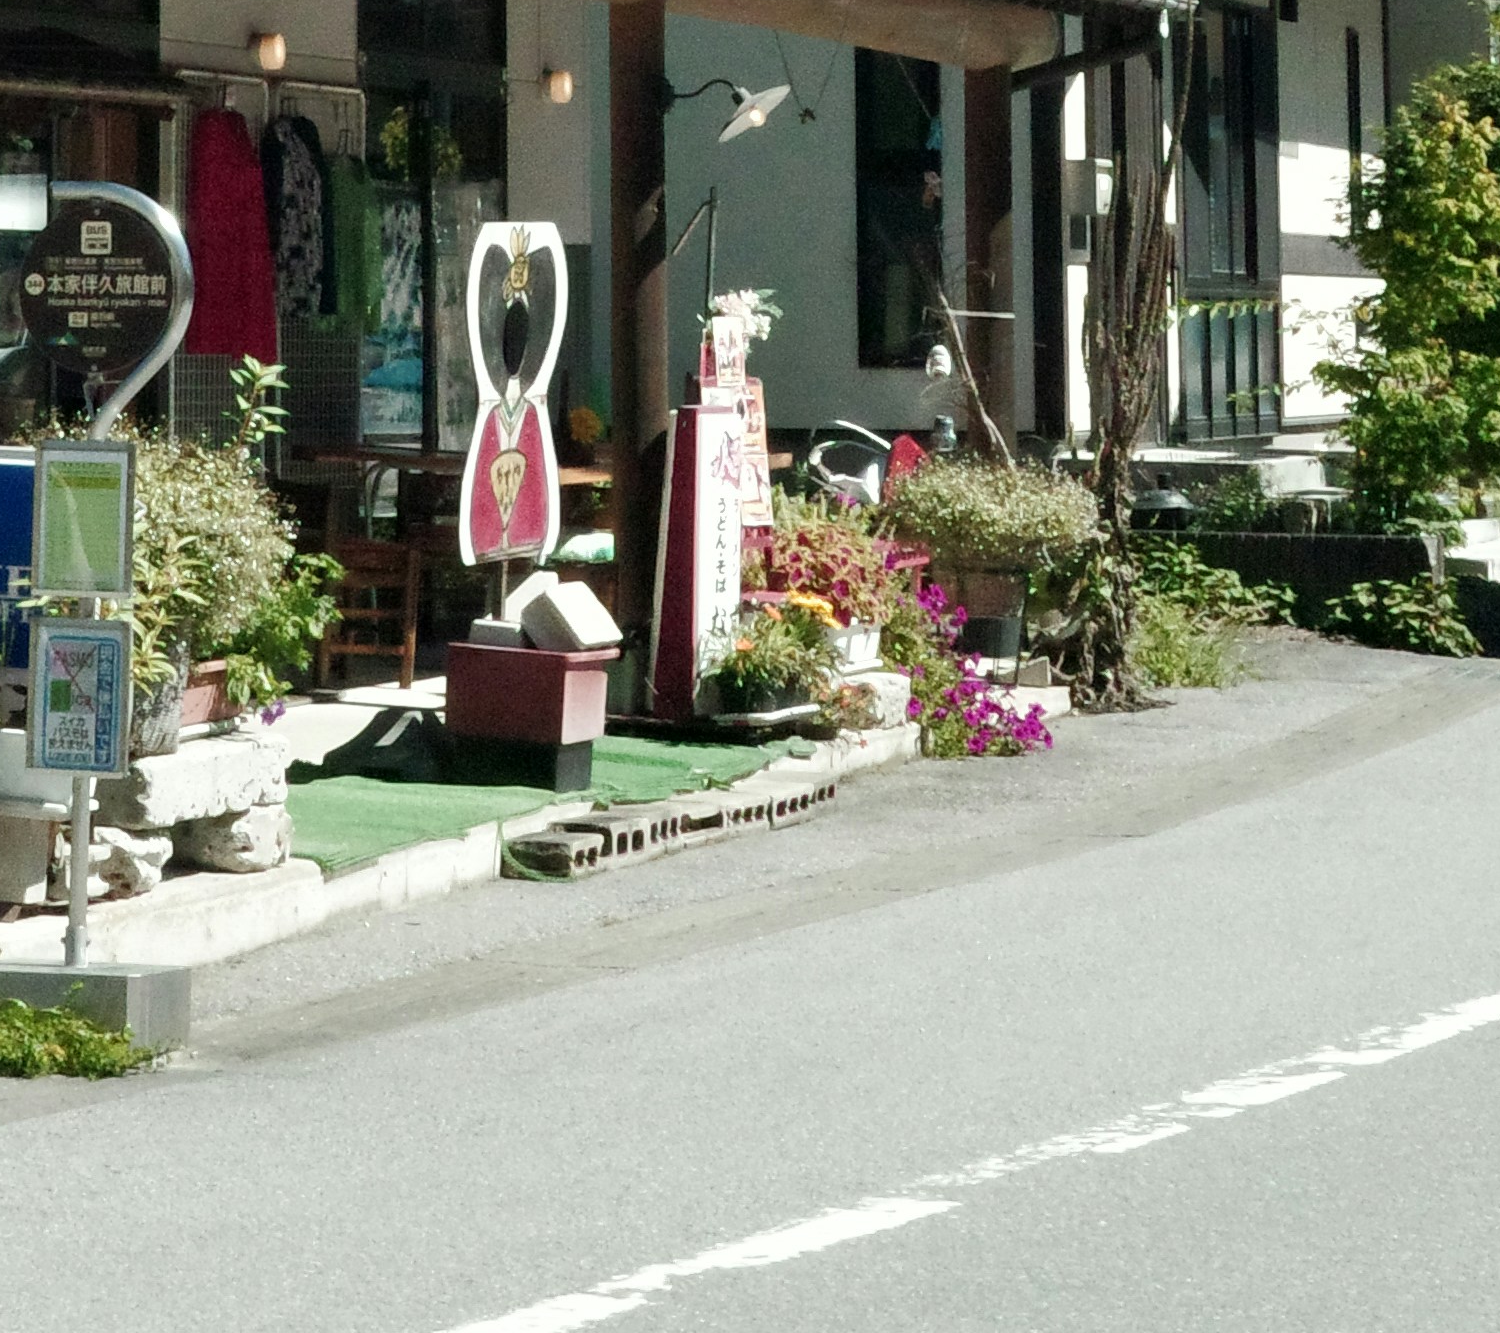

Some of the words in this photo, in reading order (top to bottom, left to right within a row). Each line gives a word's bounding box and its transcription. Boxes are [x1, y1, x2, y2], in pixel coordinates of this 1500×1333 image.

[85, 225, 107, 235] BUS
[47, 273, 167, 296] 本家伴久旅館前
[715, 498, 729, 593] うどん・そば
[58, 715, 86, 727] スイカ
[52, 727, 89, 739] パスモは
